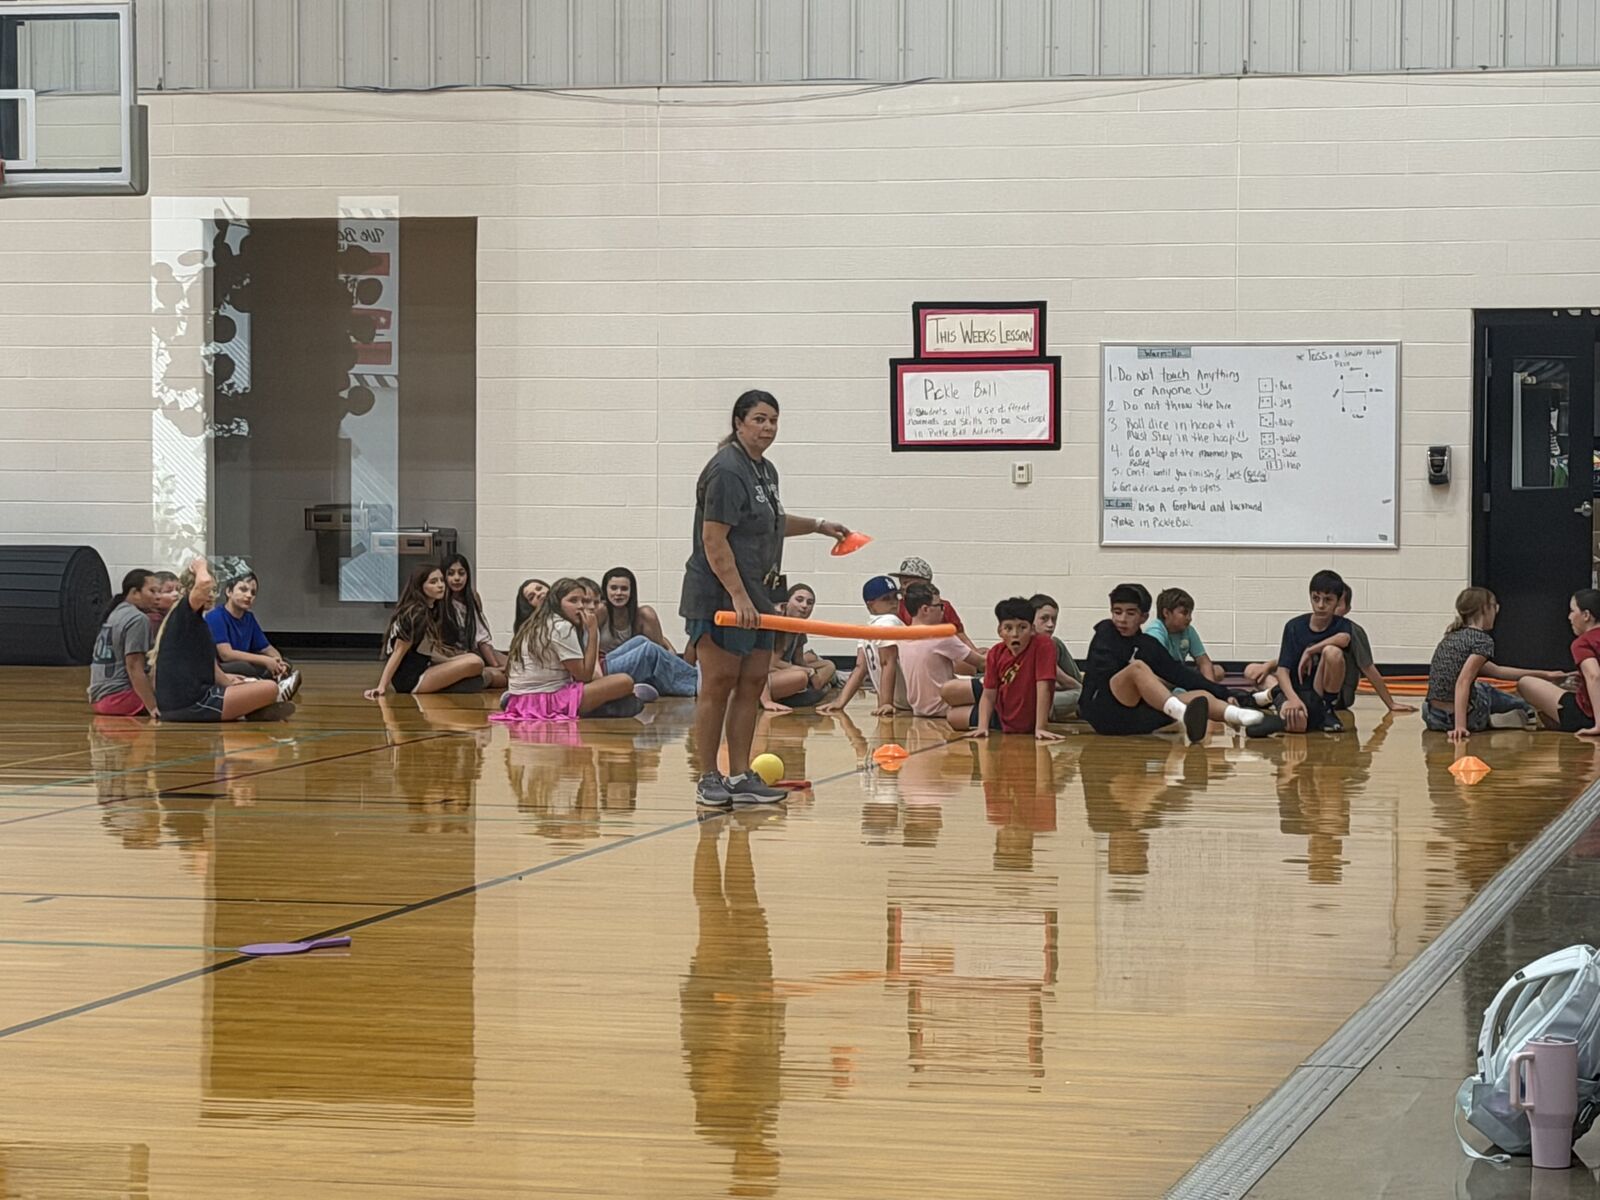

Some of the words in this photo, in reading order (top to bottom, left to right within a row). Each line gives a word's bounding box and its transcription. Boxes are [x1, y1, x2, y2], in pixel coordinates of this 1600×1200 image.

[999, 320, 1033, 344] LESSON
[1118, 366, 1132, 381] Do
[1197, 368, 1240, 383] Anything
[1133, 387, 1145, 397] or
[1152, 386, 1192, 398] Anyone
[955, 405, 971, 416] will
[1123, 400, 1139, 411] Do
[1144, 400, 1161, 410] not
[1165, 400, 1193, 411] throw
[1196, 399, 1214, 410] the
[943, 418, 956, 426] and
[1126, 416, 1145, 429] Roll
[1148, 418, 1169, 430] dice
[1175, 420, 1188, 430] in
[1175, 433, 1189, 443] in
[1191, 432, 1209, 443] the
[1210, 501, 1225, 512] and
[1140, 519, 1150, 528] in
